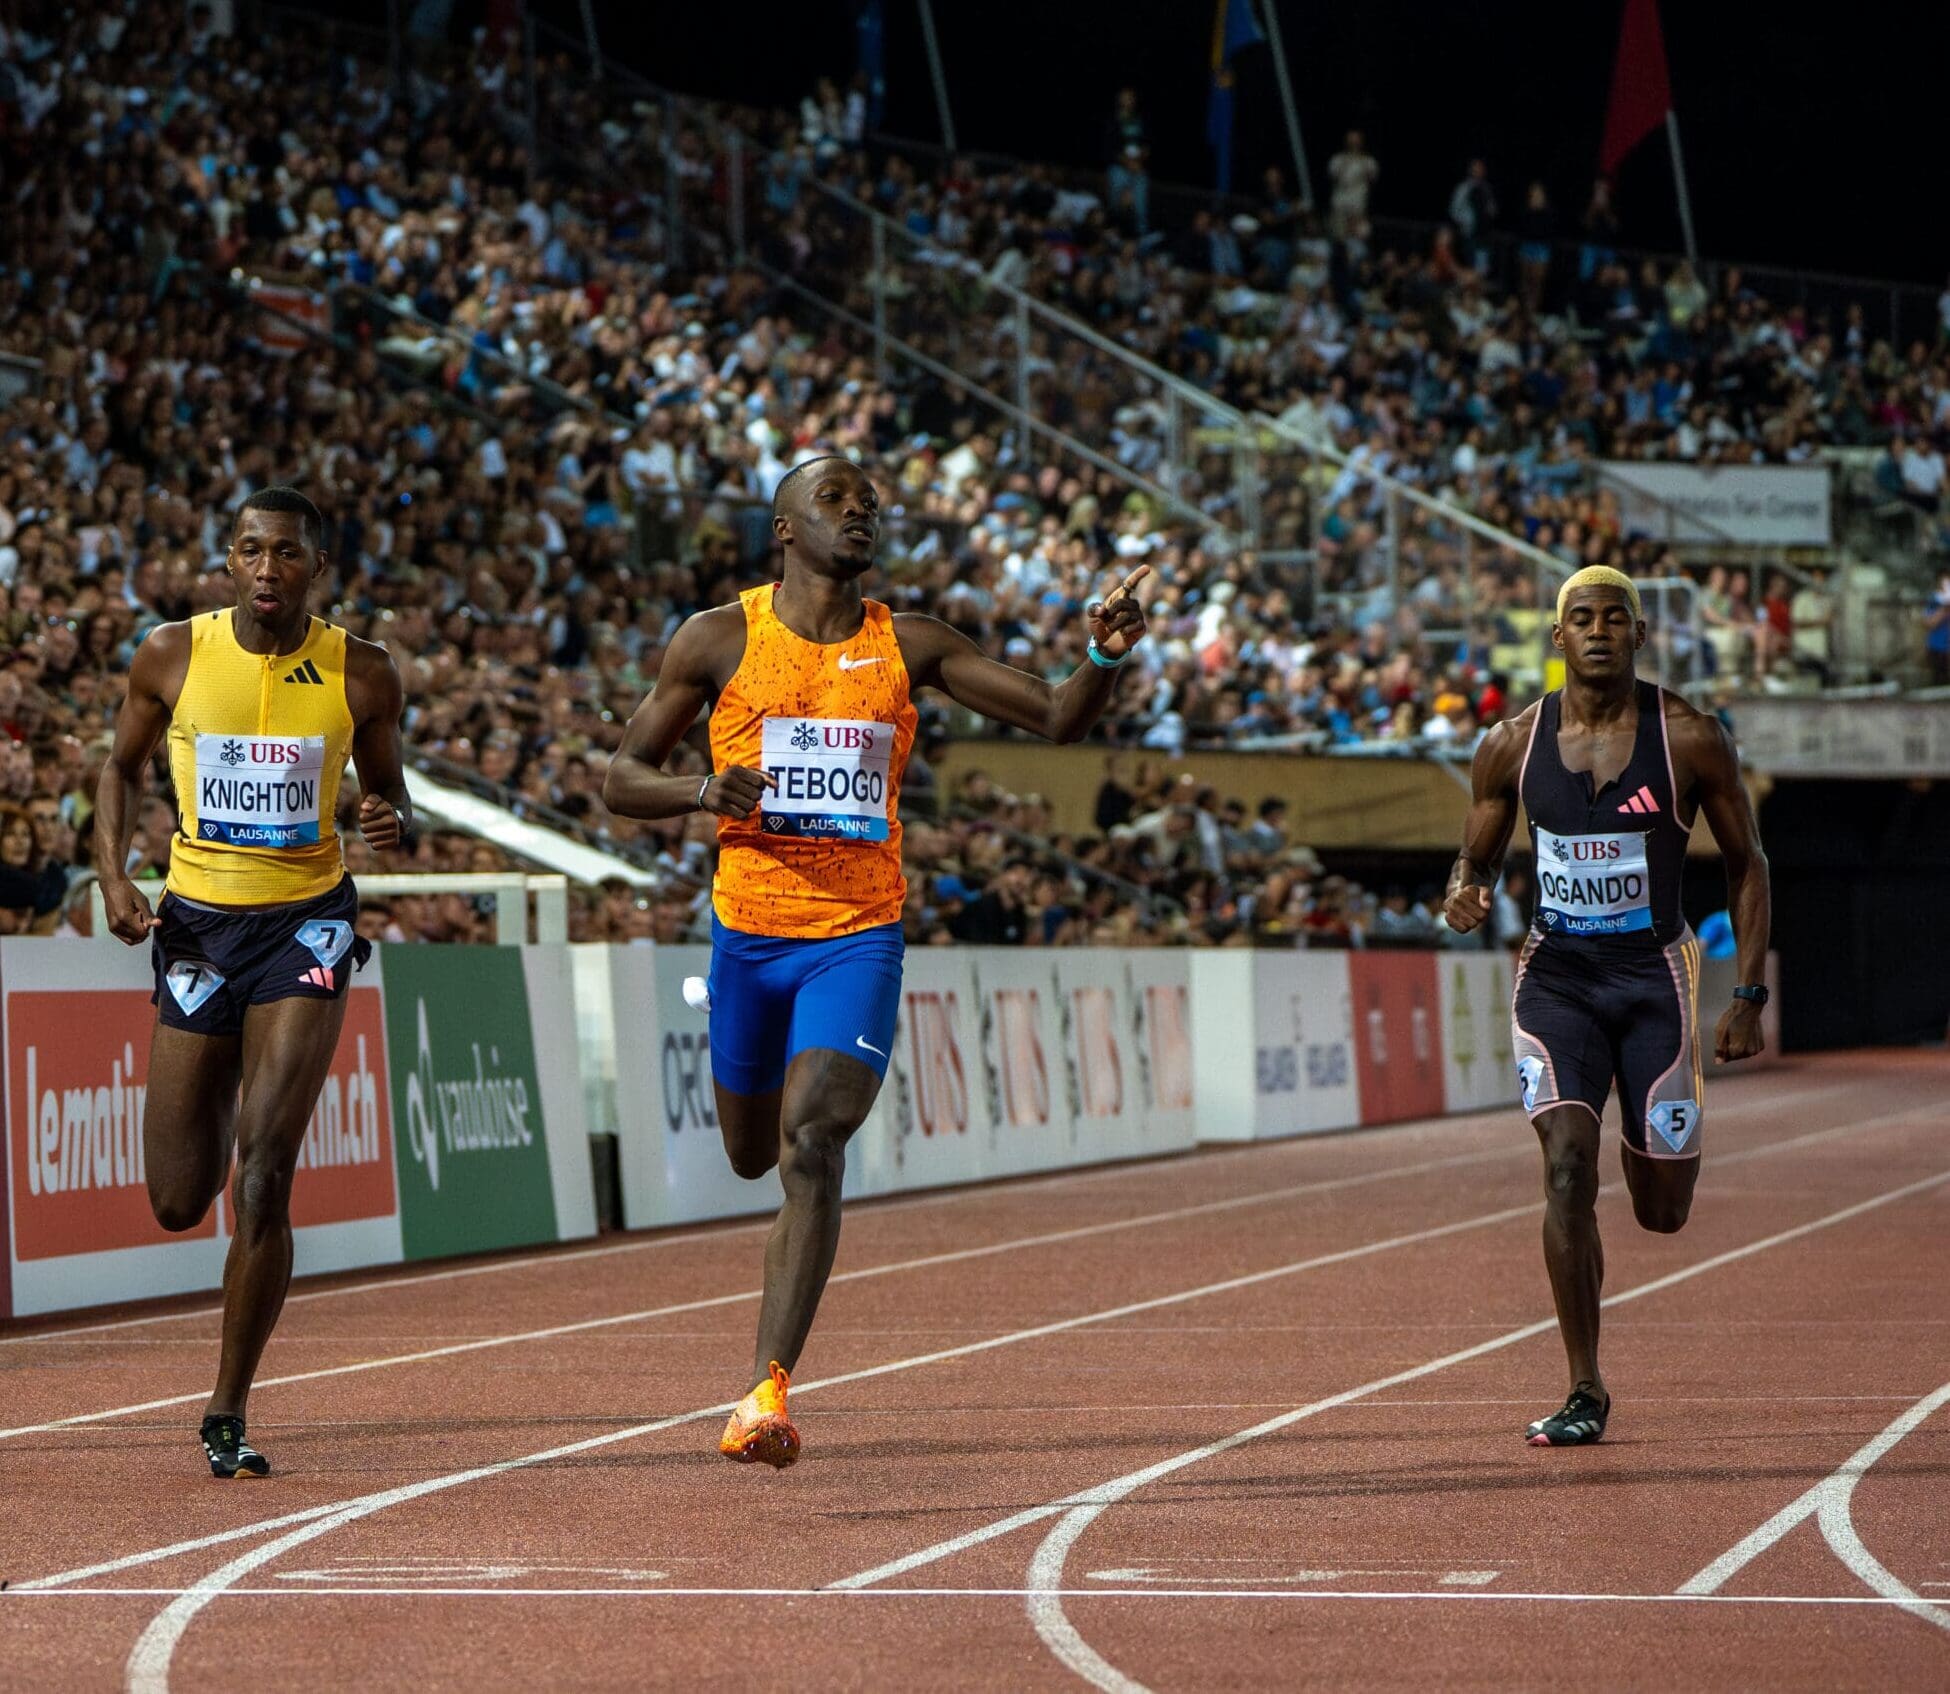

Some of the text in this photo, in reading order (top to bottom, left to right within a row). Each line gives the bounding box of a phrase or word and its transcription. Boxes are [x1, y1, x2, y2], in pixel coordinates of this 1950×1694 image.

[823, 726, 875, 750] UBS
[249, 742, 301, 765] UBS
[202, 776, 315, 812] KNIGHTON
[768, 766, 882, 804] TEBOGO
[230, 826, 299, 841] LAUSANNE
[800, 818, 871, 833] LAUSANNE
[1571, 840, 1621, 861] UBS
[1542, 871, 1642, 905] OGANDO
[1566, 917, 1628, 931] LAUSANNE
[320, 926, 337, 950] 7
[185, 968, 201, 994] 7
[1671, 1107, 1686, 1132] 5
